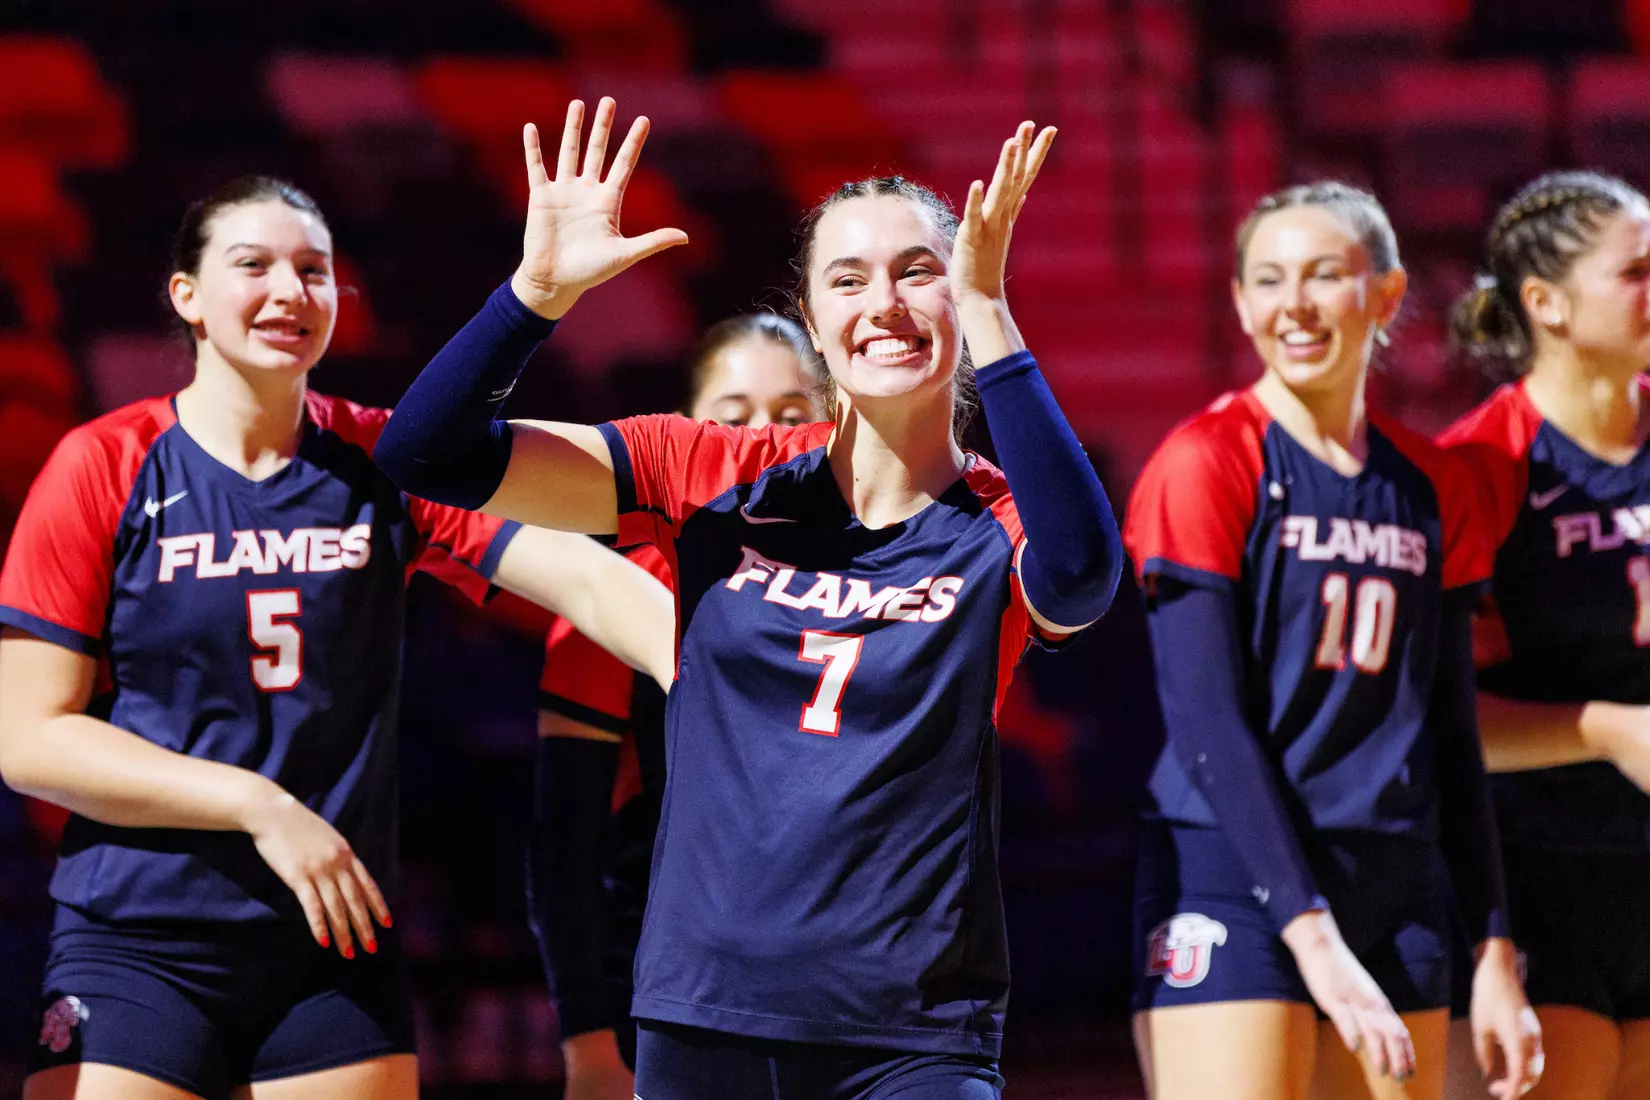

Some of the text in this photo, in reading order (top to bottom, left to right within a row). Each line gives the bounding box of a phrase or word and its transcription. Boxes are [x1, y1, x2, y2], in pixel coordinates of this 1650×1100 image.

[157, 523, 371, 583] FLAMES
[725, 545, 964, 622] FLAMES
[1281, 515, 1428, 576] FLAMES
[245, 587, 303, 693] 5
[1315, 572, 1396, 675] 10
[797, 628, 865, 737] 7
